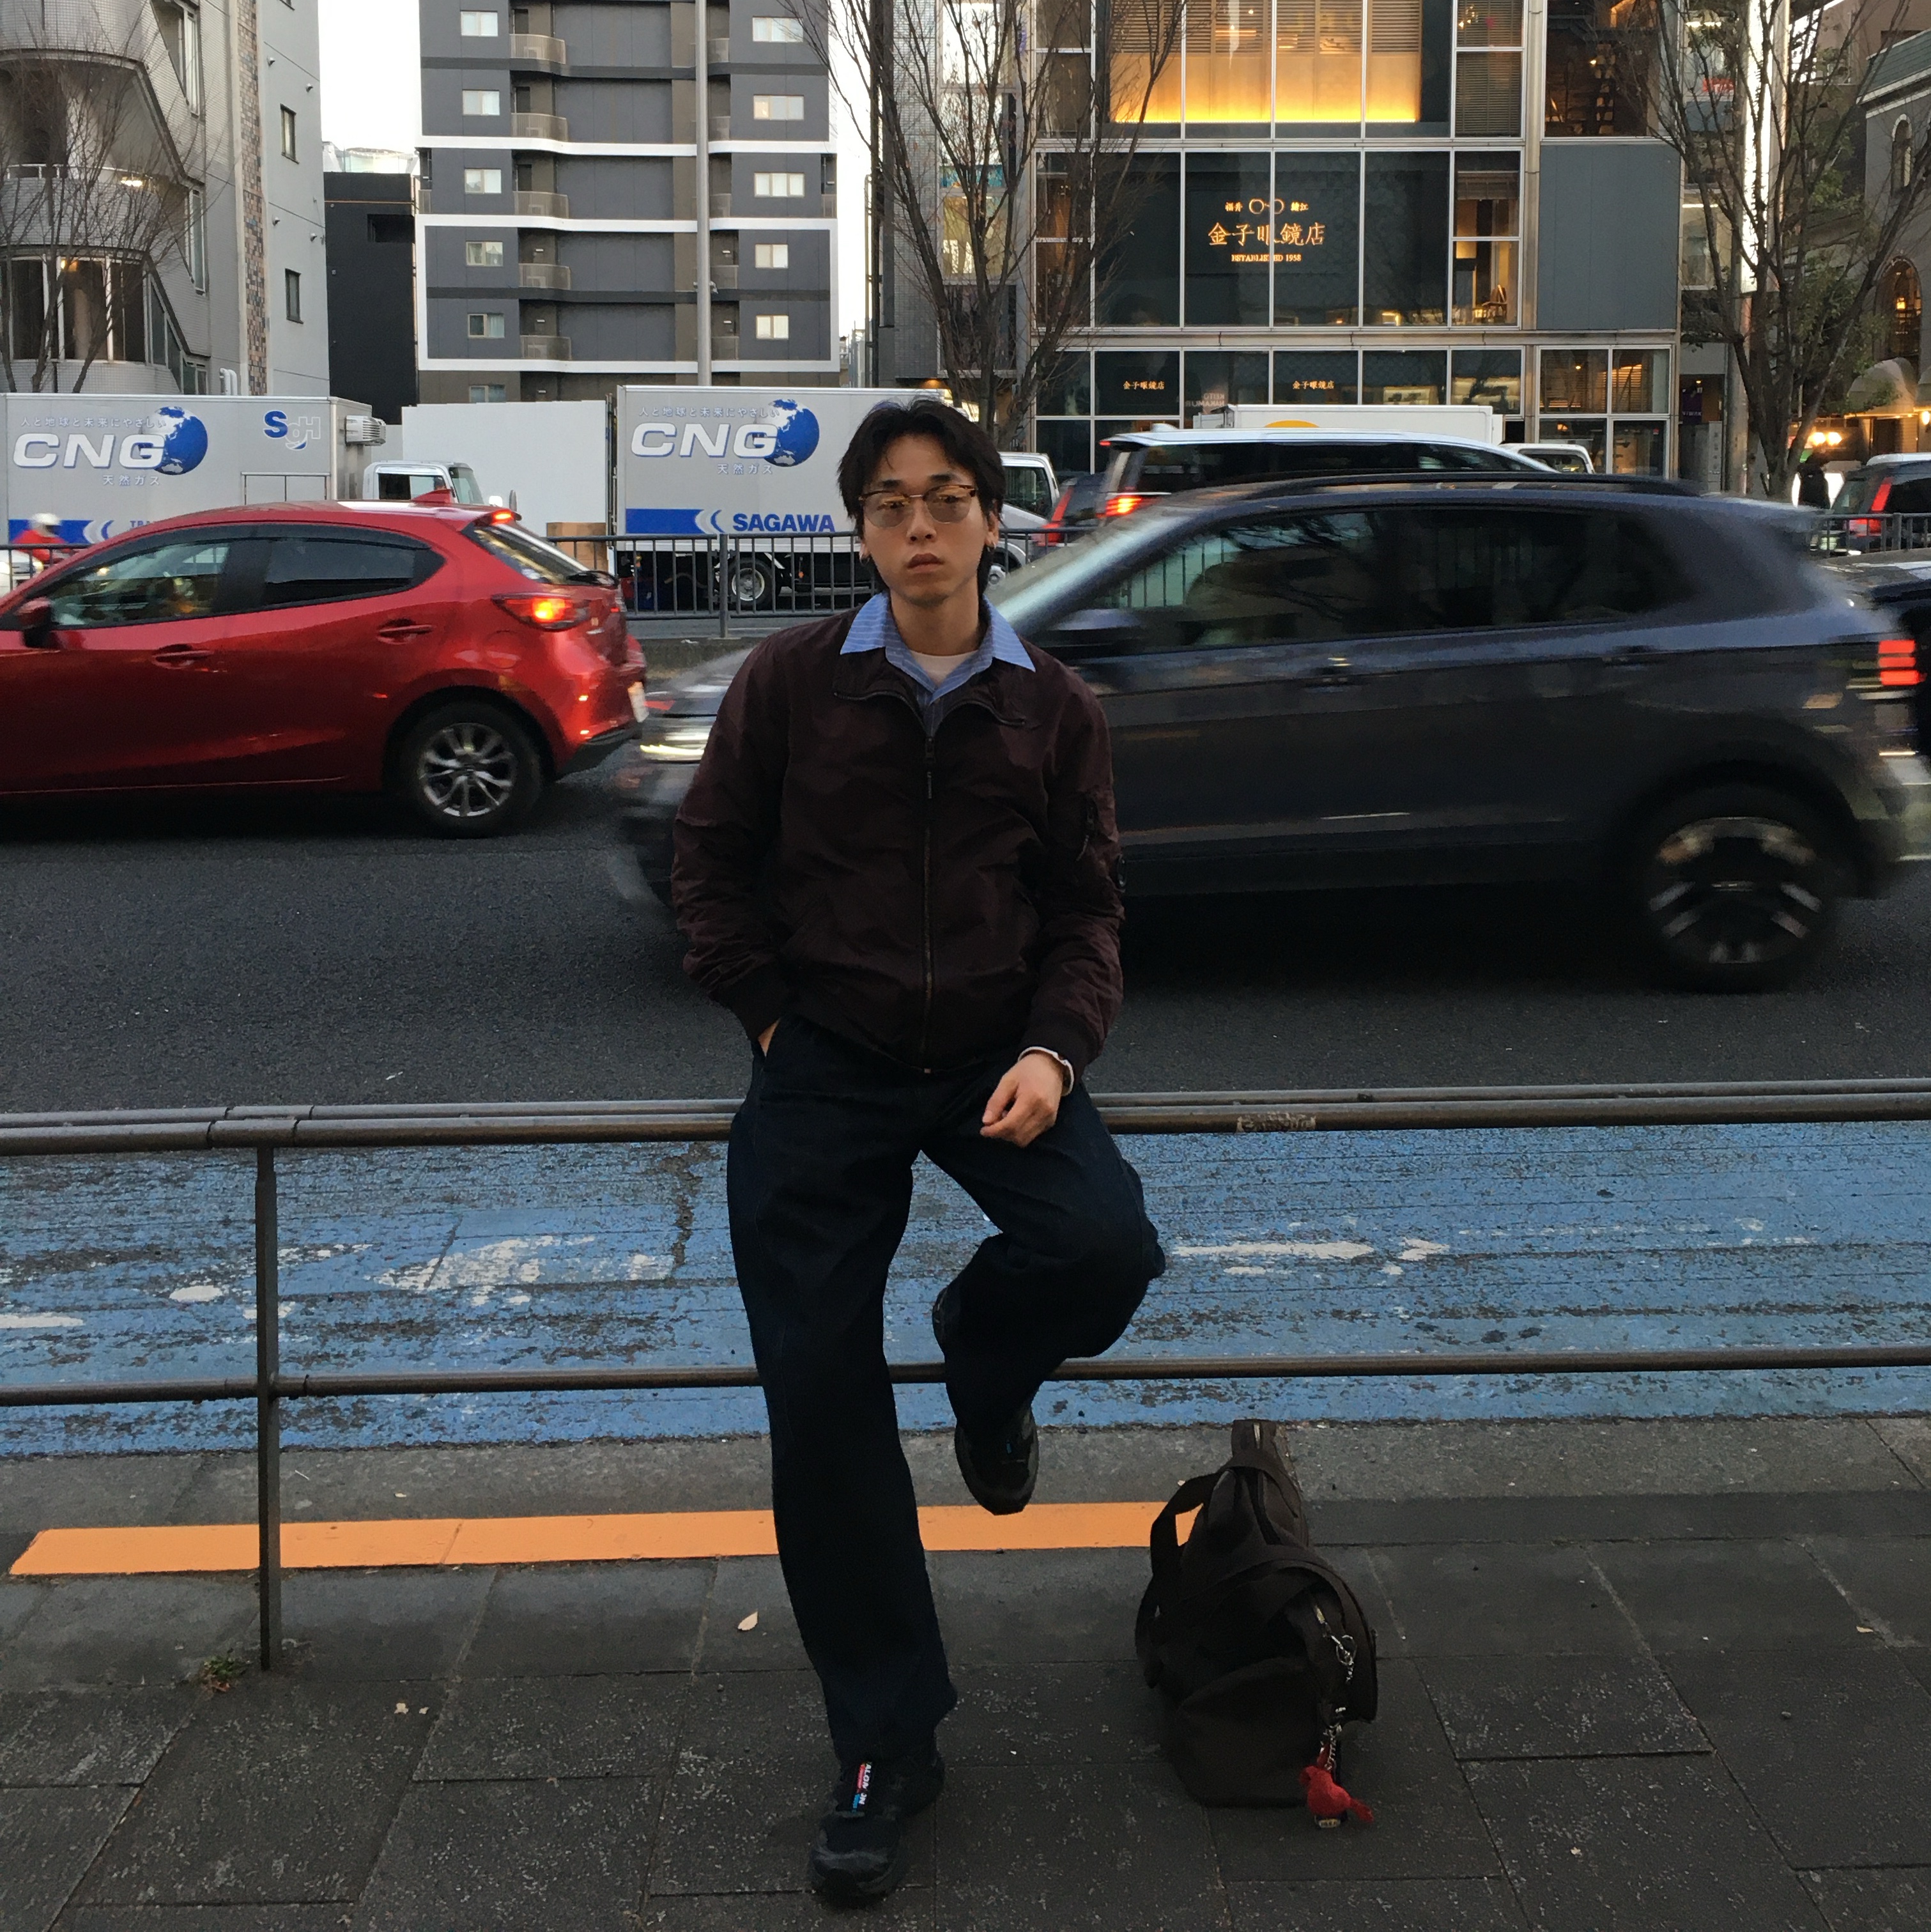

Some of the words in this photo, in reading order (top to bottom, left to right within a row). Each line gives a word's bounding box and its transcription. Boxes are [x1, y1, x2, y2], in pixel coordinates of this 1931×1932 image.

[1231, 254, 1283, 262] ESTABLISED
[1286, 254, 1302, 262] 1958
[640, 406, 780, 417] 人と地球と未来にやさしい
[20, 417, 167, 428] 人と地球と未来にやさしい
[631, 422, 778, 458] CNG
[13, 433, 165, 468] CNG
[717, 463, 773, 474] 天然ガス
[103, 475, 160, 486] 天然ガス
[732, 513, 835, 532] SAGAWA
